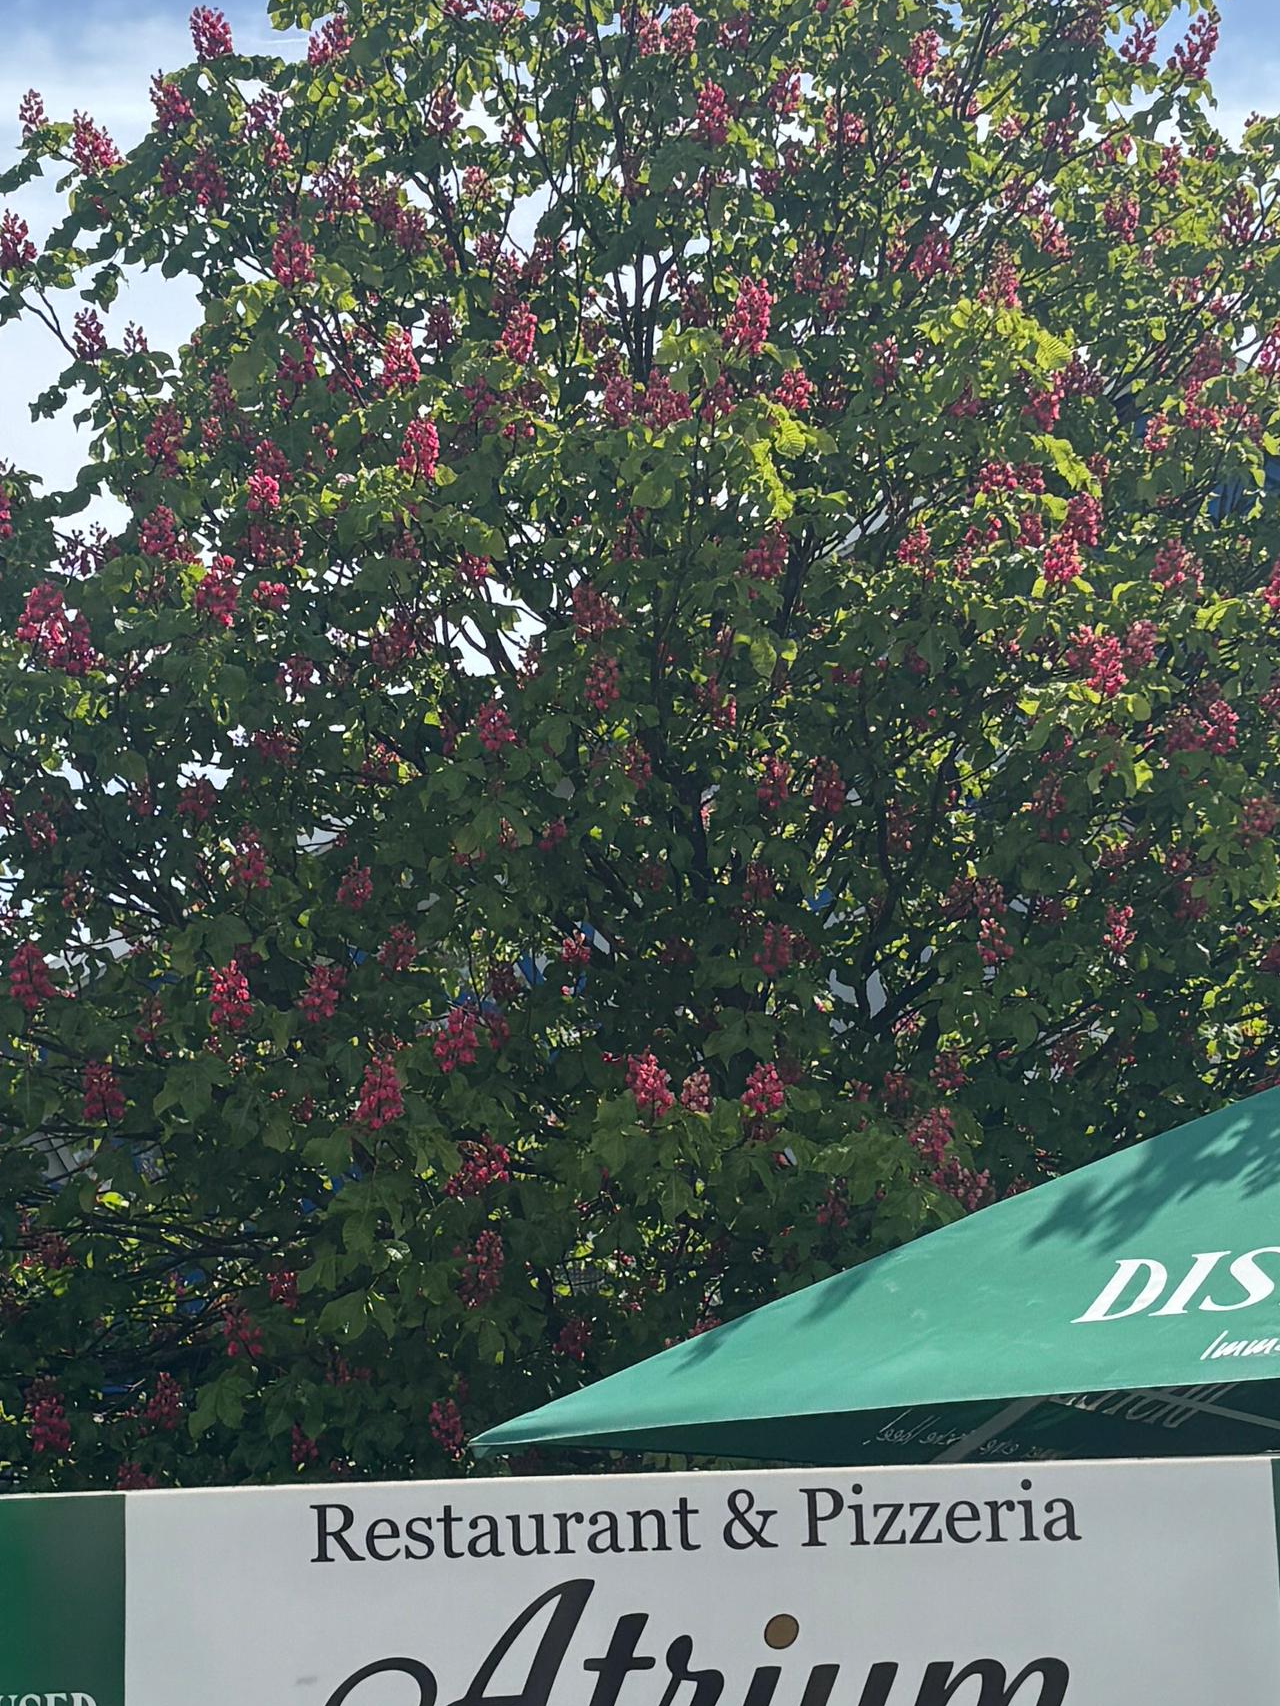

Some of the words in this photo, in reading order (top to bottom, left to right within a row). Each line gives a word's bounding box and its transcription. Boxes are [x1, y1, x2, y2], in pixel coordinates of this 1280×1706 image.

[310, 1496, 701, 1563] Restaurant
[723, 1489, 779, 1550] &
[800, 1479, 1082, 1546] Pizzeria
